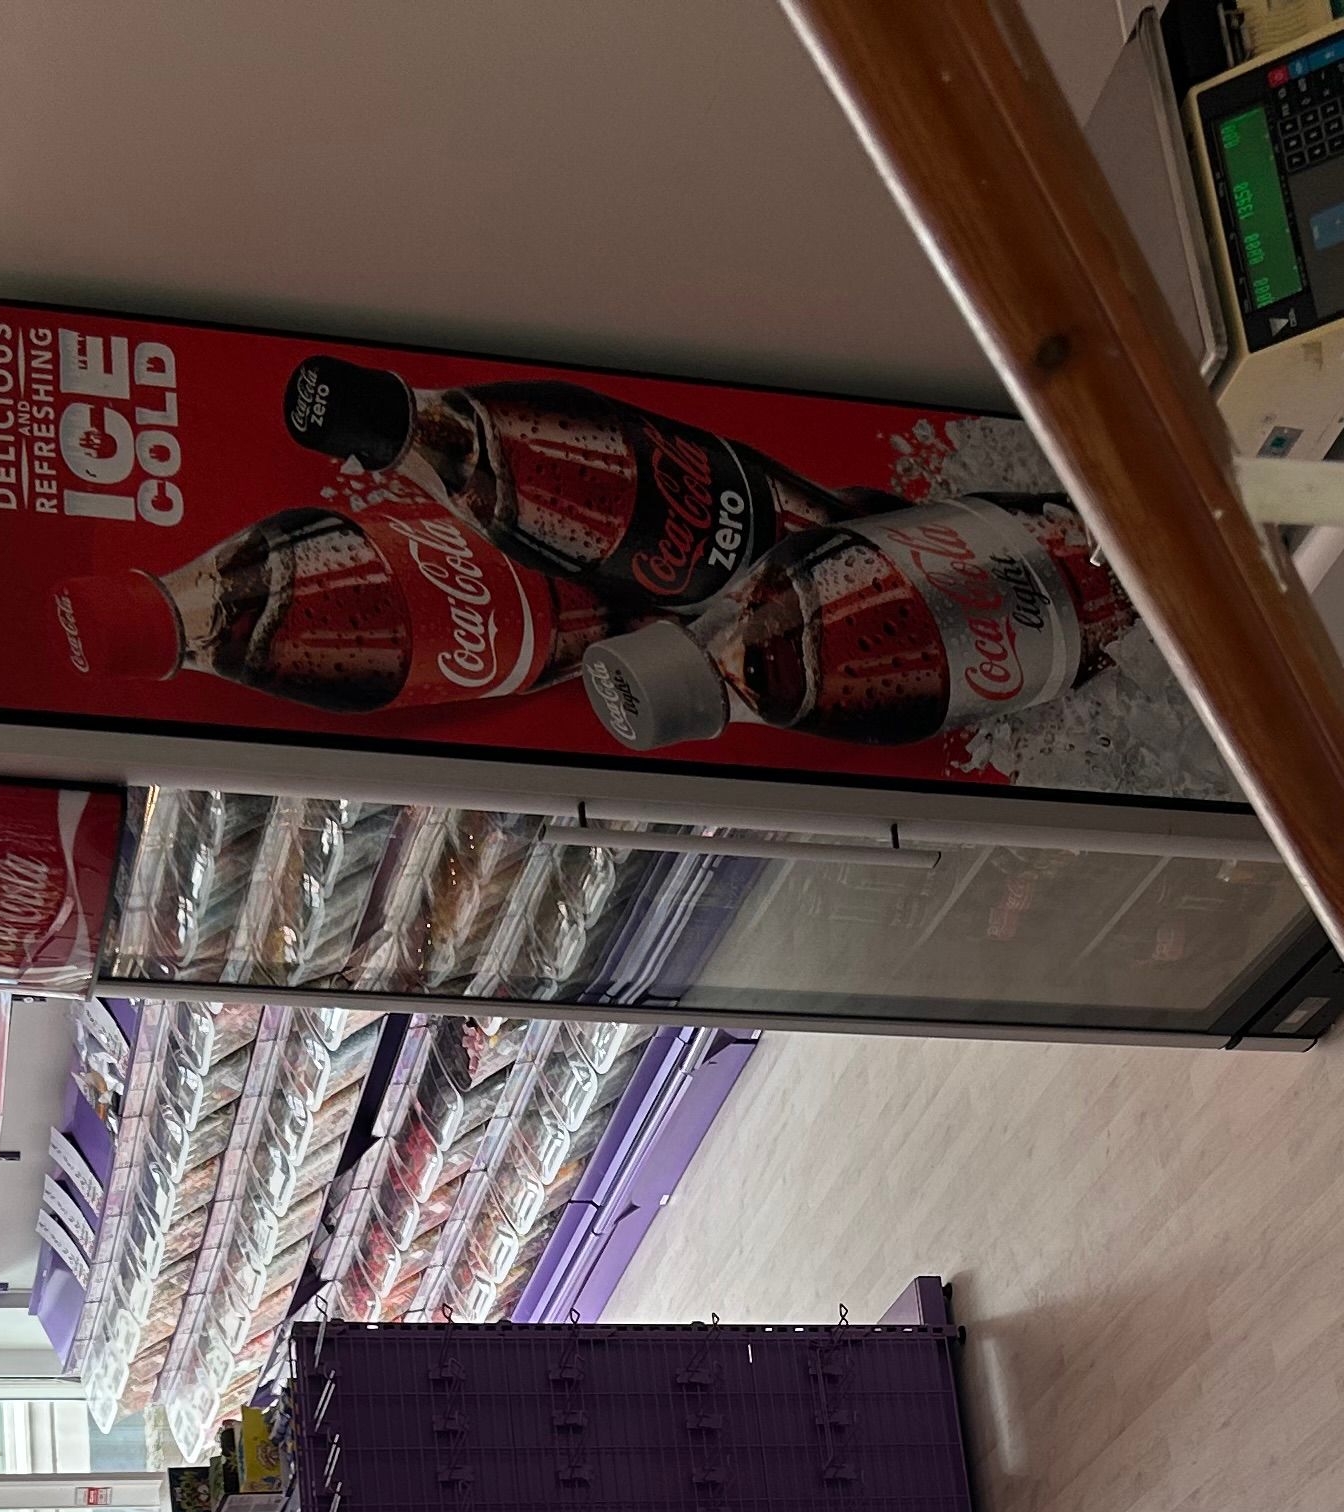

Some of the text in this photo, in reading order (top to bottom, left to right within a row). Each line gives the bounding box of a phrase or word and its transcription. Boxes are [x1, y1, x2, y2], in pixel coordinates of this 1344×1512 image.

[15, 400, 31, 437] AND
[29, 326, 58, 514] REFRESHING
[57, 327, 136, 522] ICE
[134, 341, 185, 526] COLD
[289, 366, 320, 433] Coca-Cola
[309, 383, 331, 427] zero
[630, 422, 713, 596] Coca-Cola
[707, 490, 745, 569] zero
[54, 586, 91, 673] Coca-Cola
[383, 513, 500, 687] Coca-Cola
[886, 524, 1025, 701] Coca-Cola
[987, 550, 1052, 631] light
[586, 661, 637, 740] Coca-Cola
